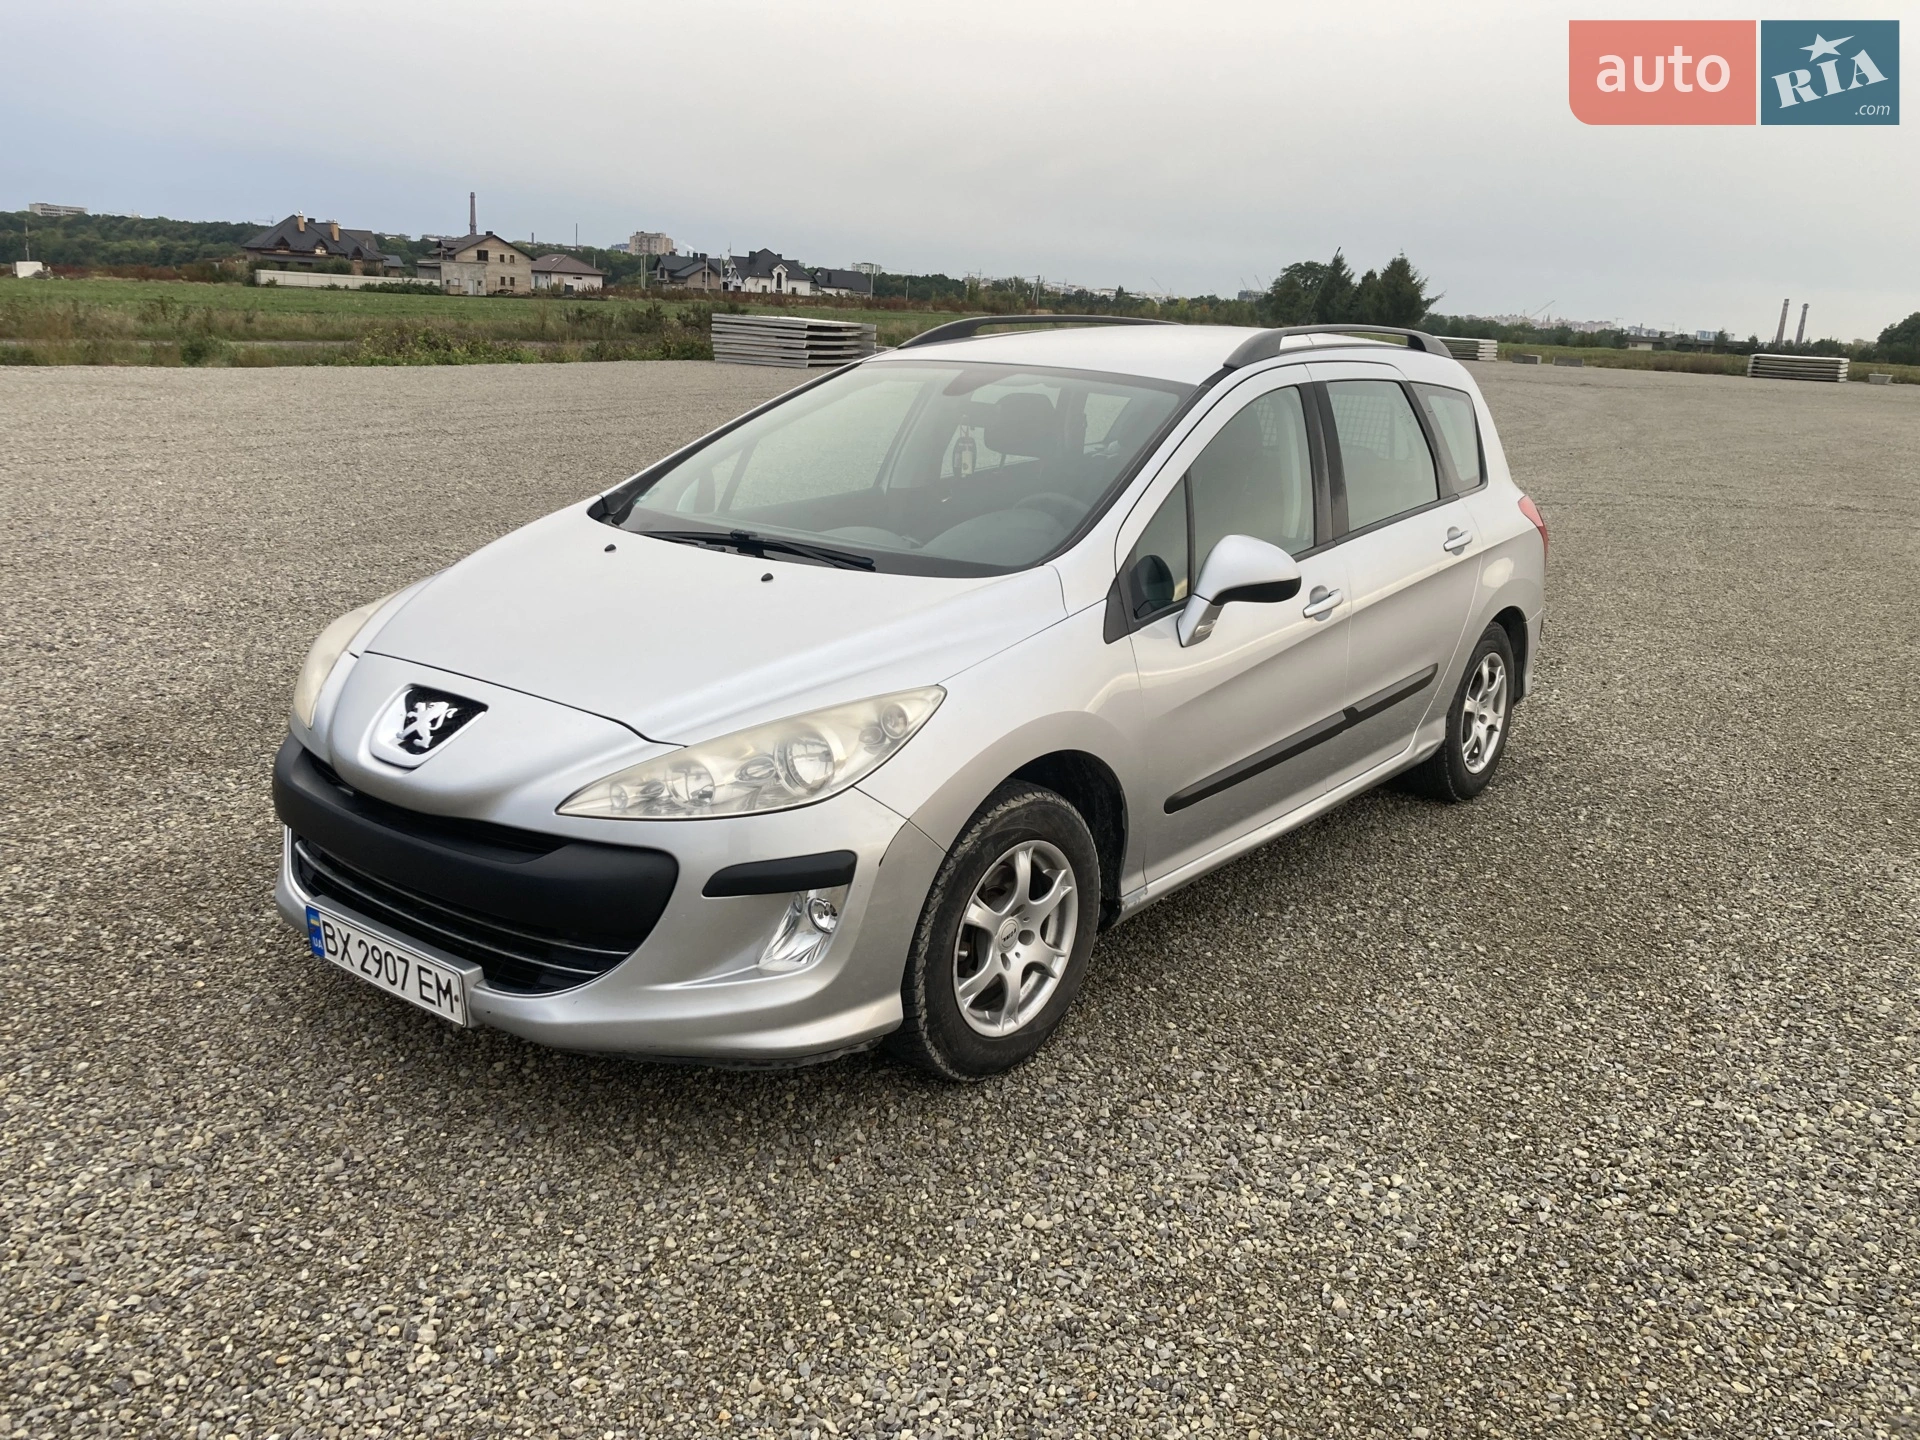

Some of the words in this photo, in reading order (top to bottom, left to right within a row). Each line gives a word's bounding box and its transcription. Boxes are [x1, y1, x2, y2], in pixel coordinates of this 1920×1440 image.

[312, 936, 323, 949] UA
[322, 920, 354, 967] BX
[358, 939, 410, 991] 2907
[417, 964, 454, 1014] EM
